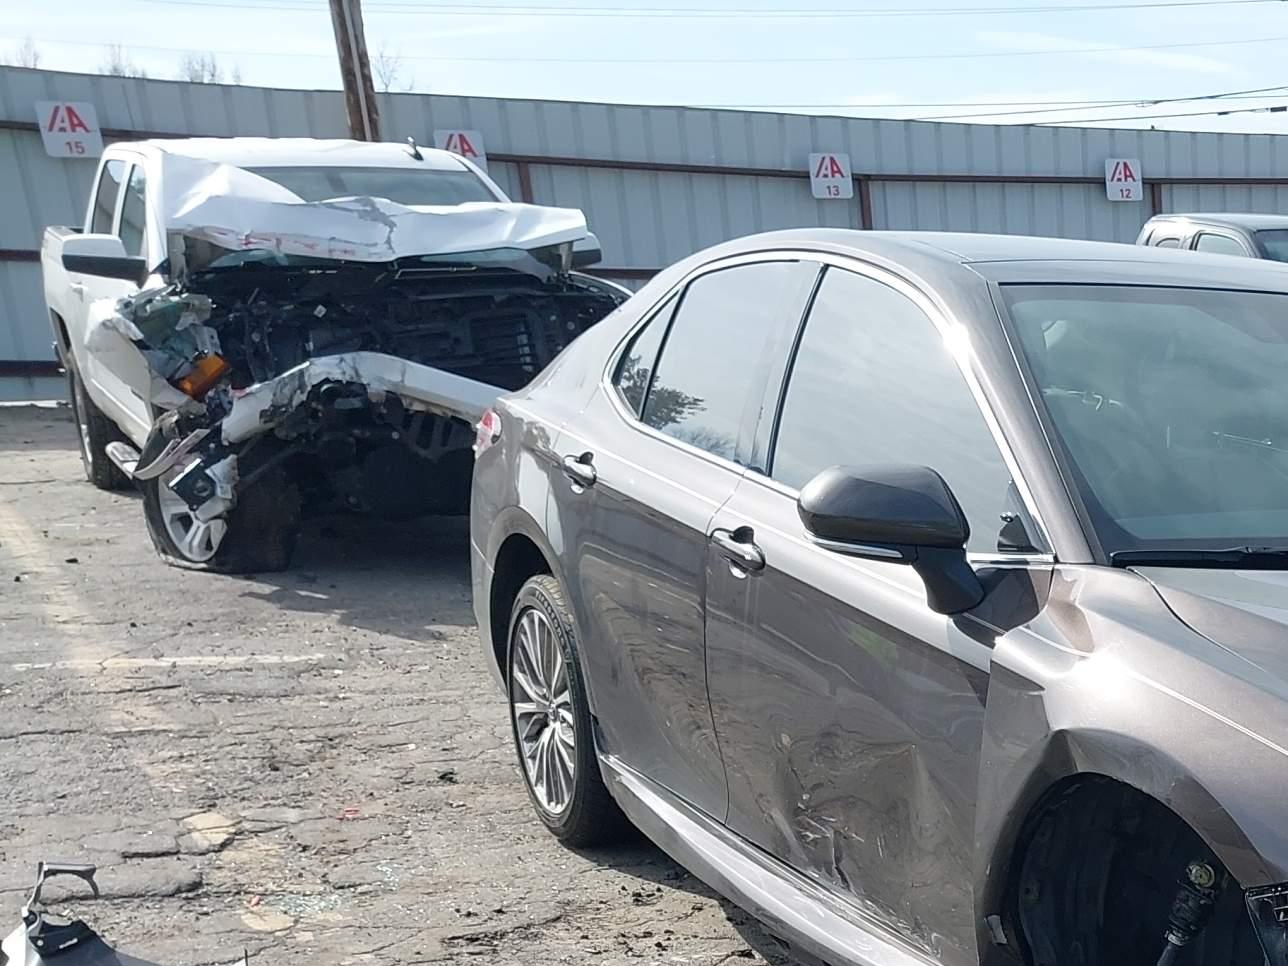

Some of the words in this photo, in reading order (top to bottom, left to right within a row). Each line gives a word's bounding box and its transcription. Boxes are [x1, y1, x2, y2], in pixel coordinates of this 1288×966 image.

[65, 141, 85, 154] 15
[826, 185, 840, 197] 13
[1120, 188, 1132, 199] 12
